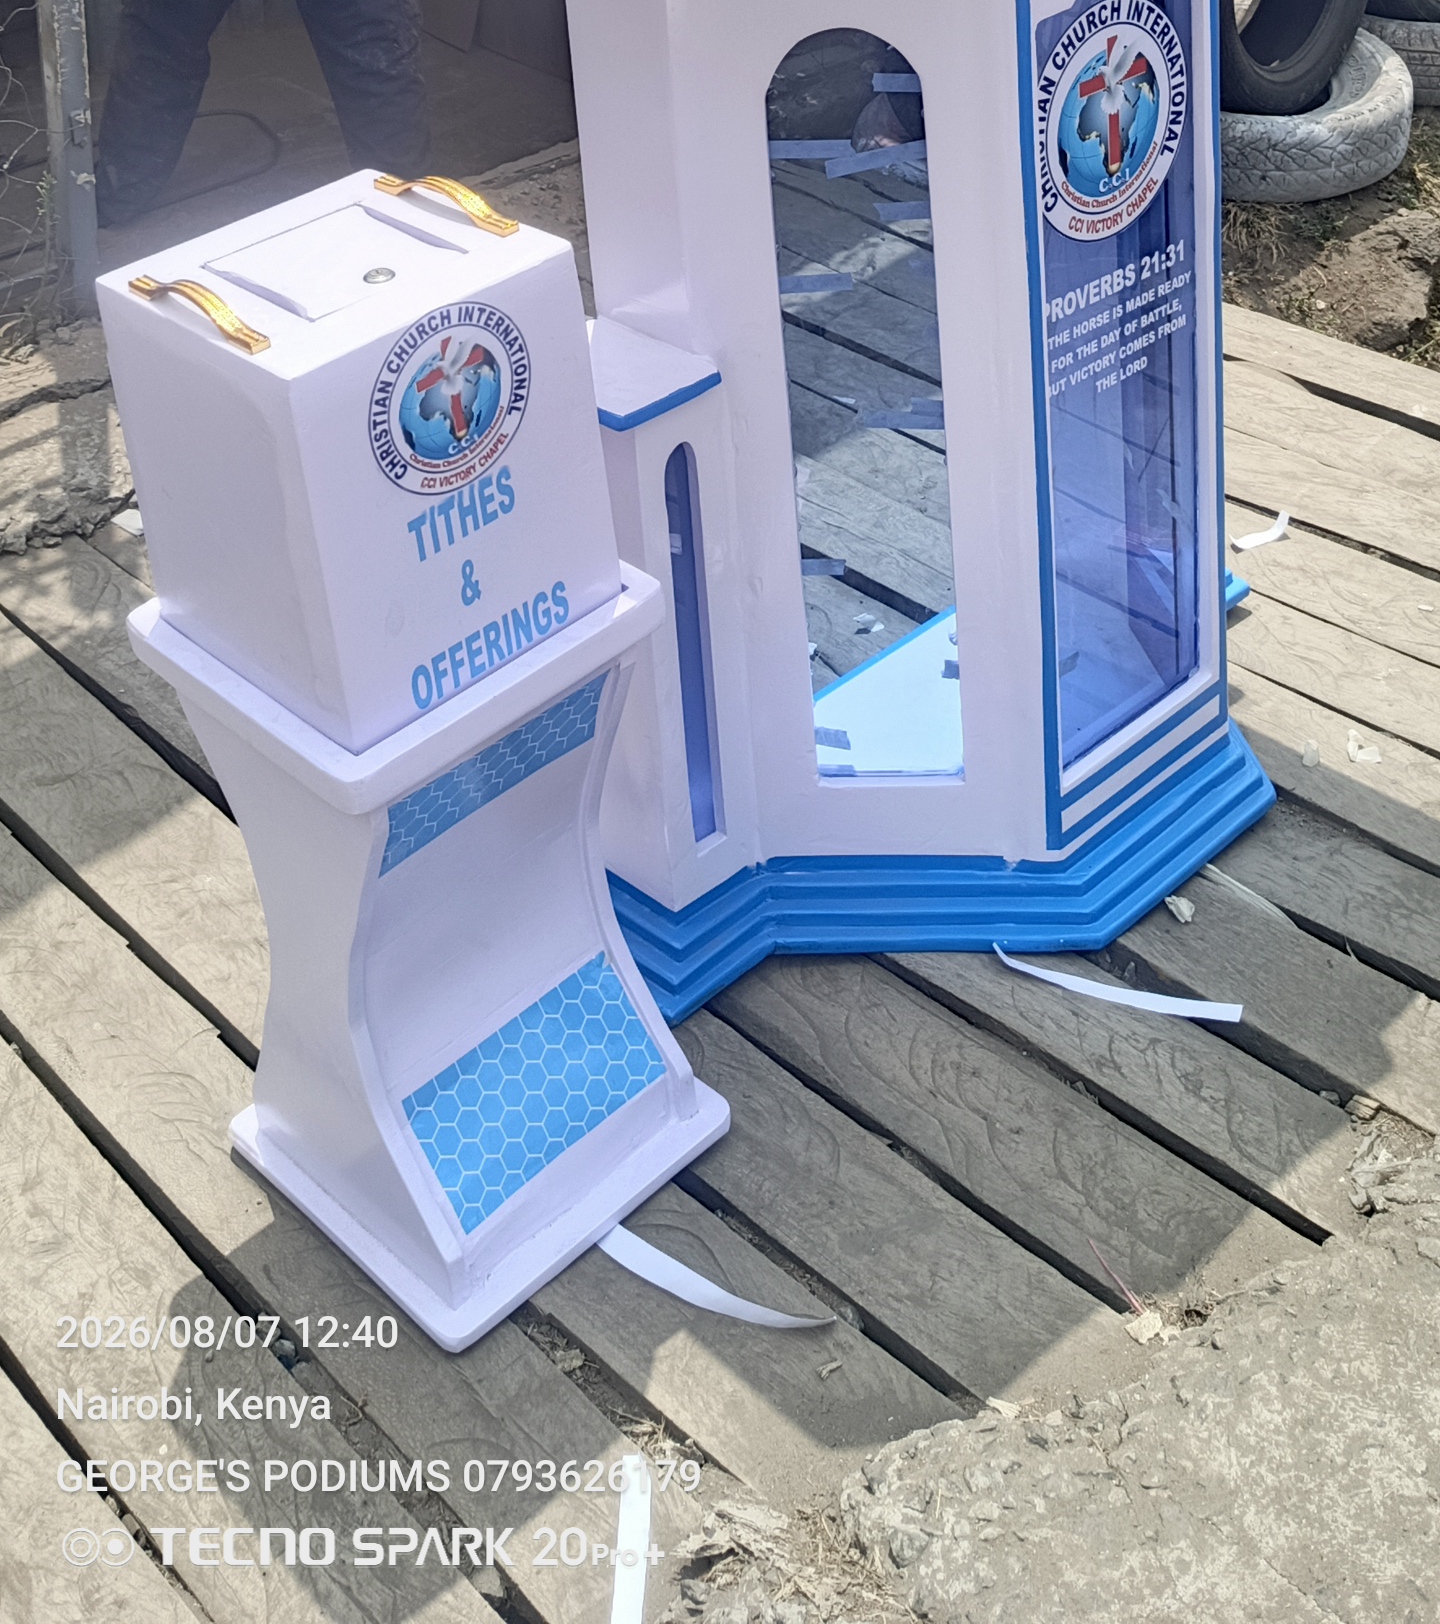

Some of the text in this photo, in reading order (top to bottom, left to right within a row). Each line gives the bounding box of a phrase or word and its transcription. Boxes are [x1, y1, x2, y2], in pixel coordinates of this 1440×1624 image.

[1061, 140, 1159, 209] Christian Church International
[1068, 176, 1159, 234] CCI VICTORY CHAPEL
[1140, 239, 1185, 280] 21:31
[1048, 271, 1192, 350] THE HORSE IS MADE READY
[1051, 298, 1183, 373] FOR THE DAY OF BATTLE,
[1069, 349, 1117, 386] VICTORY
[1119, 329, 1156, 359] COMES
[1157, 313, 1187, 340] FROM
[1095, 356, 1148, 394] THE LORD
[372, 305, 528, 480] CHRISTIAN CHURCH INTERNATIONAL
[420, 432, 509, 488] CCI VICTORY CHAPEL
[407, 464, 515, 562] TITHES
[461, 559, 482, 606] &
[411, 580, 570, 710] OFFERINGS
